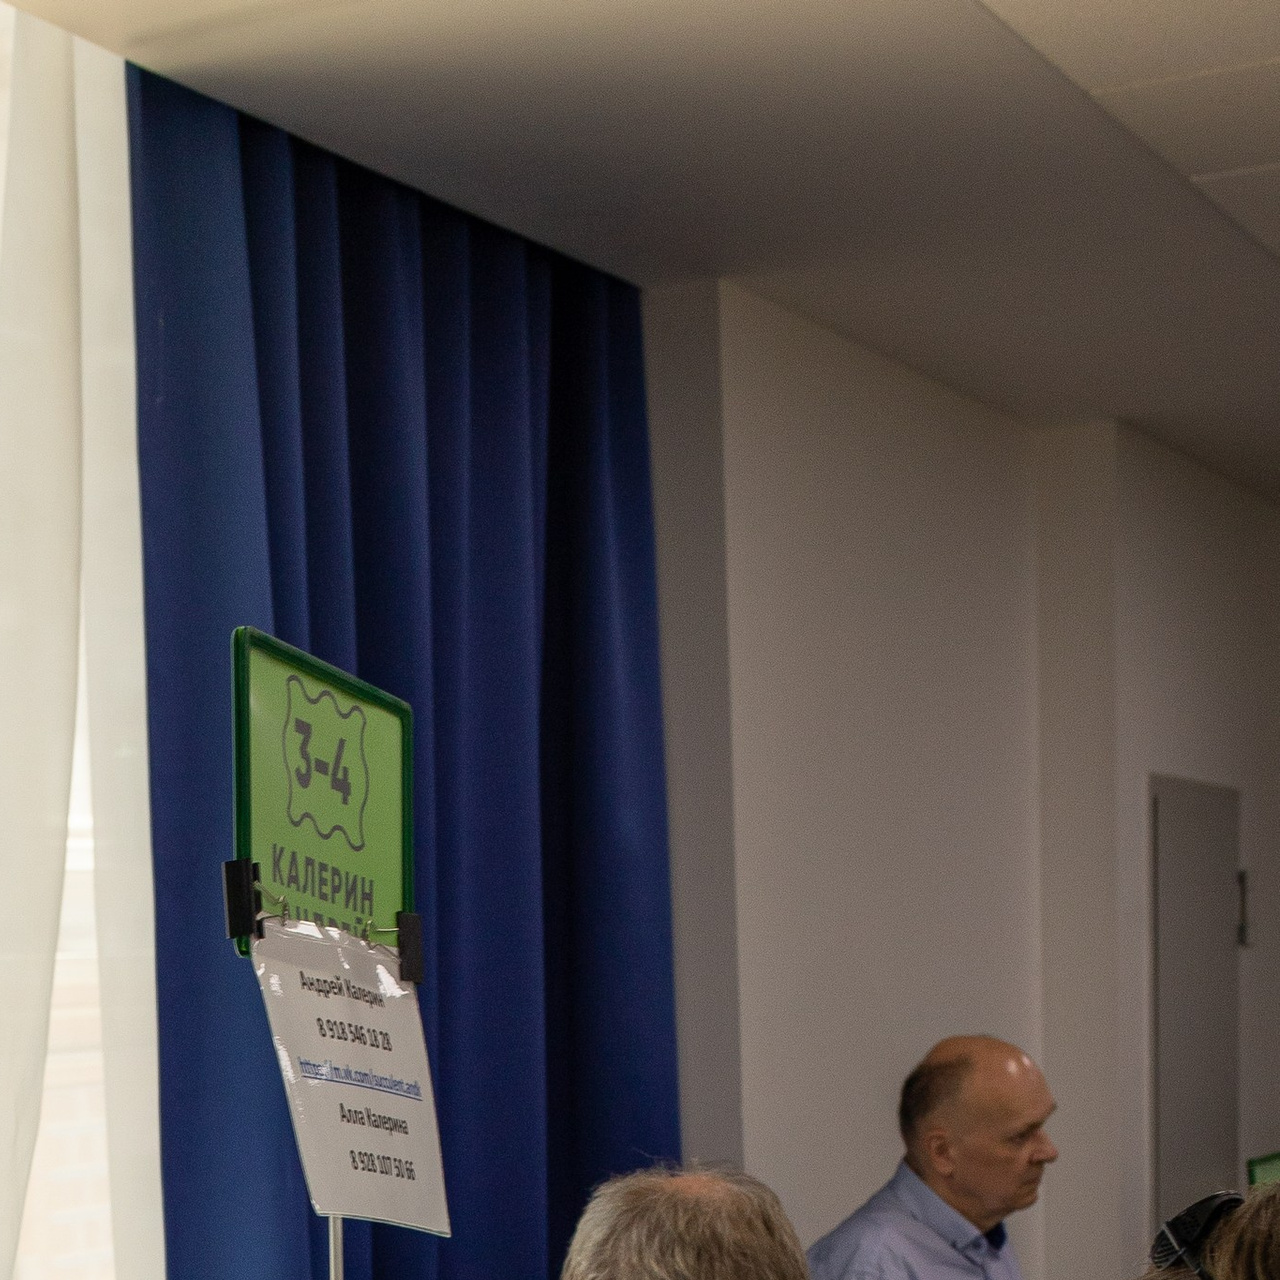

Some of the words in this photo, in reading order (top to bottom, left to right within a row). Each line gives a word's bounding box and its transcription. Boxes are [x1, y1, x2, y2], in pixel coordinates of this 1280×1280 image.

[293, 718, 353, 806] 3-4
[271, 843, 374, 916] КАЛЕРИН
[299, 970, 345, 999] Андрей
[344, 979, 385, 1009] Калерин
[316, 1017, 327, 1038] 8
[326, 1019, 348, 1042] 918
[339, 1103, 366, 1126] Алла
[364, 1107, 409, 1136] Калерина
[349, 1150, 359, 1170] 8
[358, 1151, 377, 1173] 928
